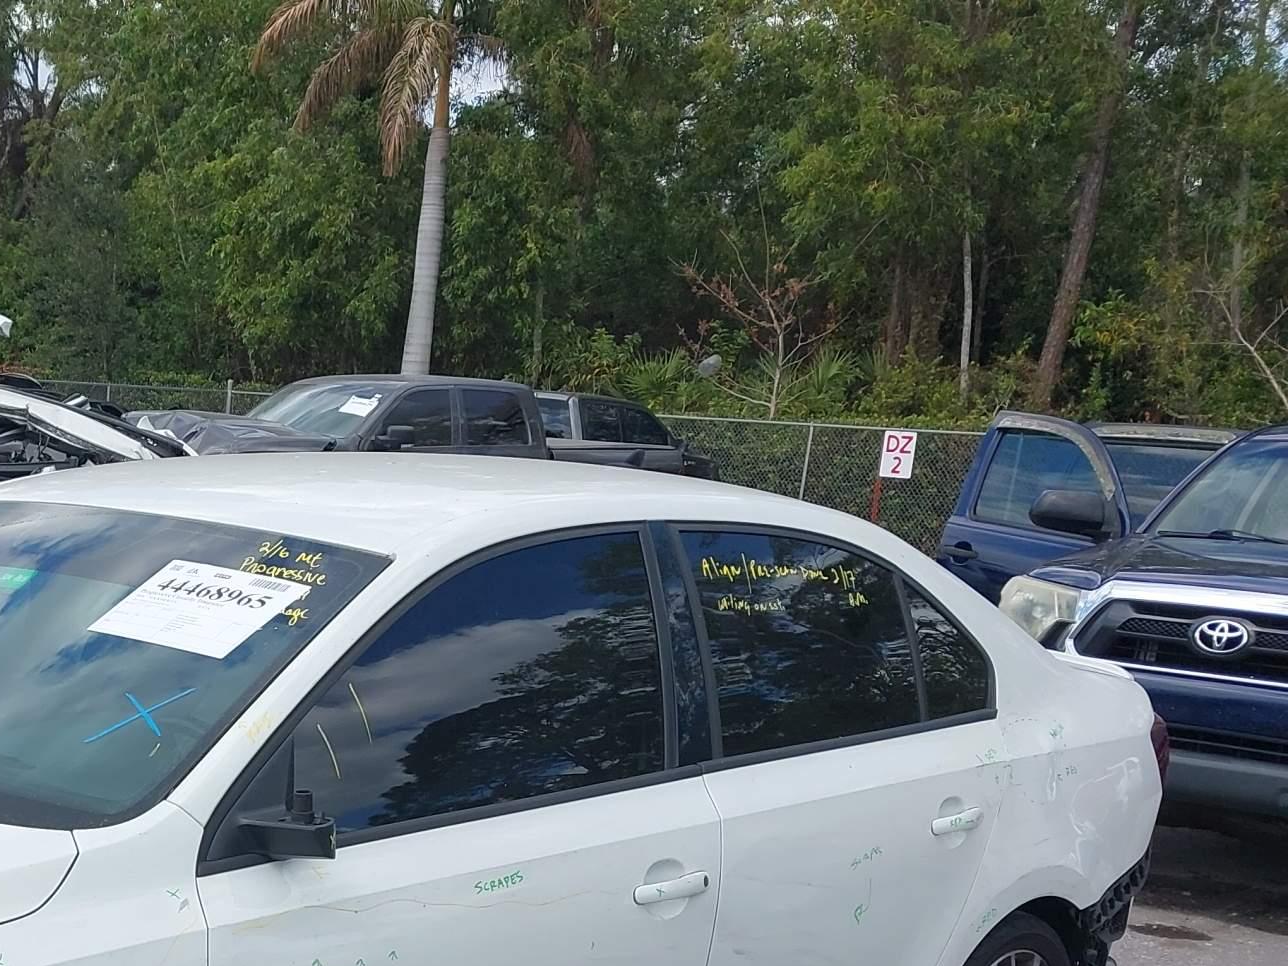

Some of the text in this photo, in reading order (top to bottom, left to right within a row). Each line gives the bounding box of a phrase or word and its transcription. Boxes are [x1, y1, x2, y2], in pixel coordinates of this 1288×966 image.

[886, 434, 914, 454] DZ
[890, 456, 902, 474] 2
[157, 577, 274, 609] 44468965
[474, 870, 525, 895] SCRAPES
